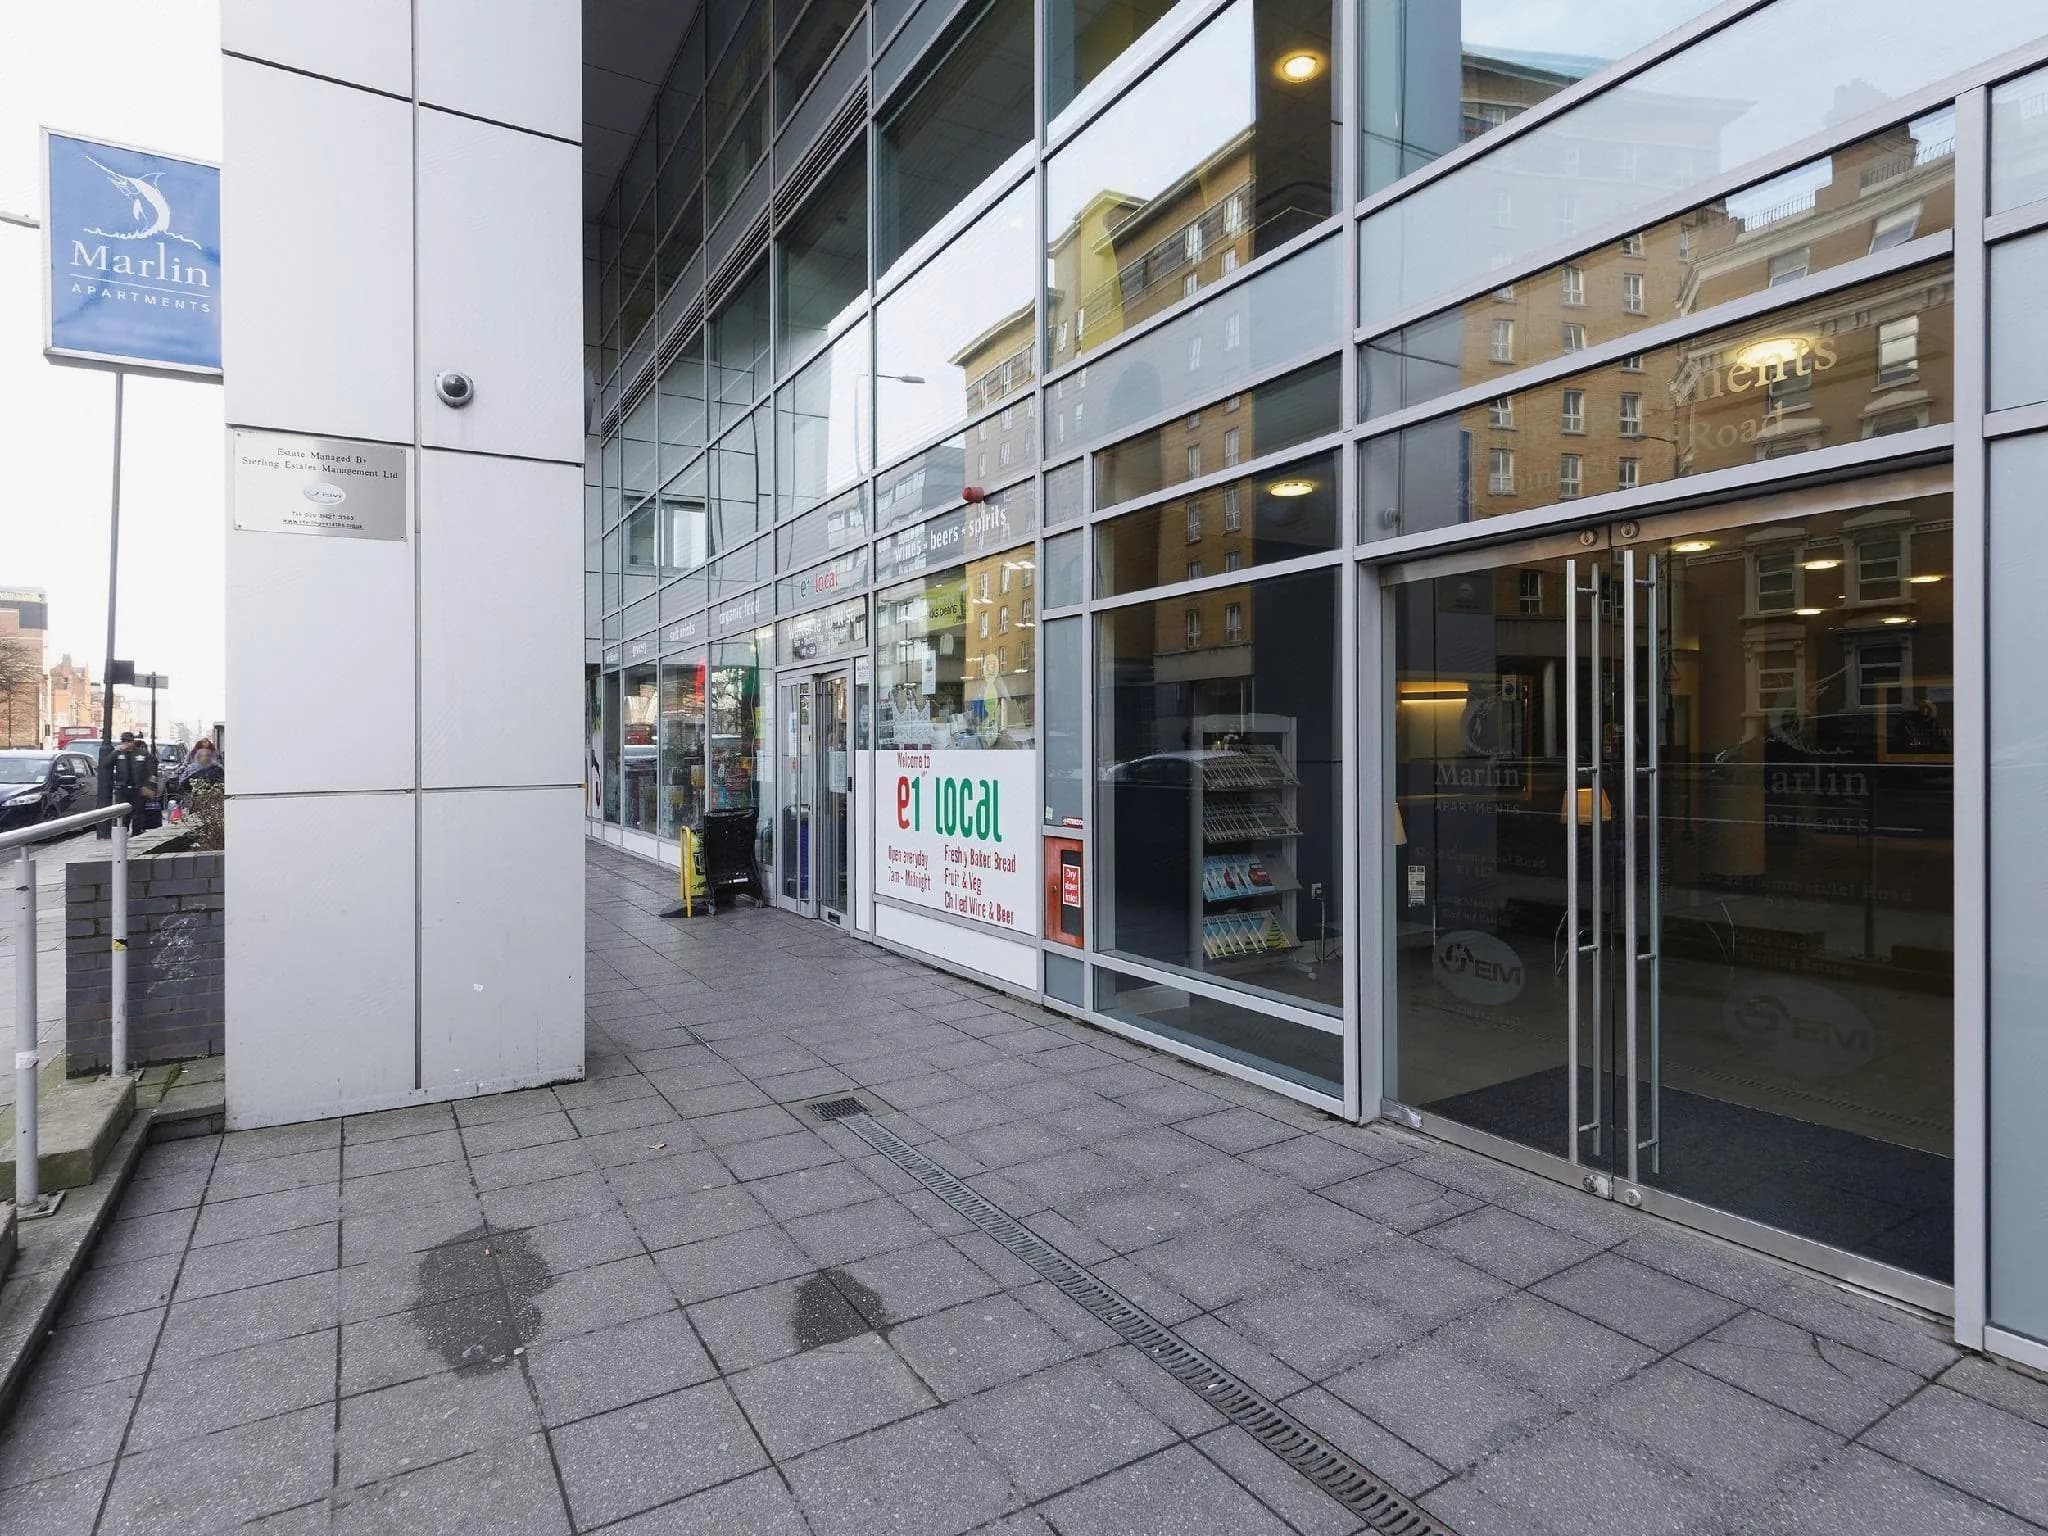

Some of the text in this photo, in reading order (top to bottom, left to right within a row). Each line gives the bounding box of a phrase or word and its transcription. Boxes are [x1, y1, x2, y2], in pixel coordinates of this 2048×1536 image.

[69, 240, 210, 287] Marlin
[72, 283, 210, 313] APARTMENTS
[242, 457, 398, 479] Sterling Estates Management Ltd
[277, 448, 368, 465] Estate Managed By
[895, 541, 922, 563] wines
[930, 525, 959, 551] beers
[968, 504, 1007, 540] spirits
[815, 571, 838, 593] local
[897, 752, 931, 769] Welcome to
[1434, 761, 1521, 788] Marlin
[1768, 764, 1870, 796] arlin
[897, 775, 1003, 843] e1 local
[1435, 799, 1522, 816] APARTMENTS
[888, 845, 929, 871] Open everyday
[944, 844, 1017, 873] Freshly Baked Bread
[905, 870, 931, 893] Midnight
[944, 867, 982, 896] Fruit & Veg
[1065, 868, 1077, 881] Dry
[944, 891, 1015, 926] Chilled Wine & Beer
